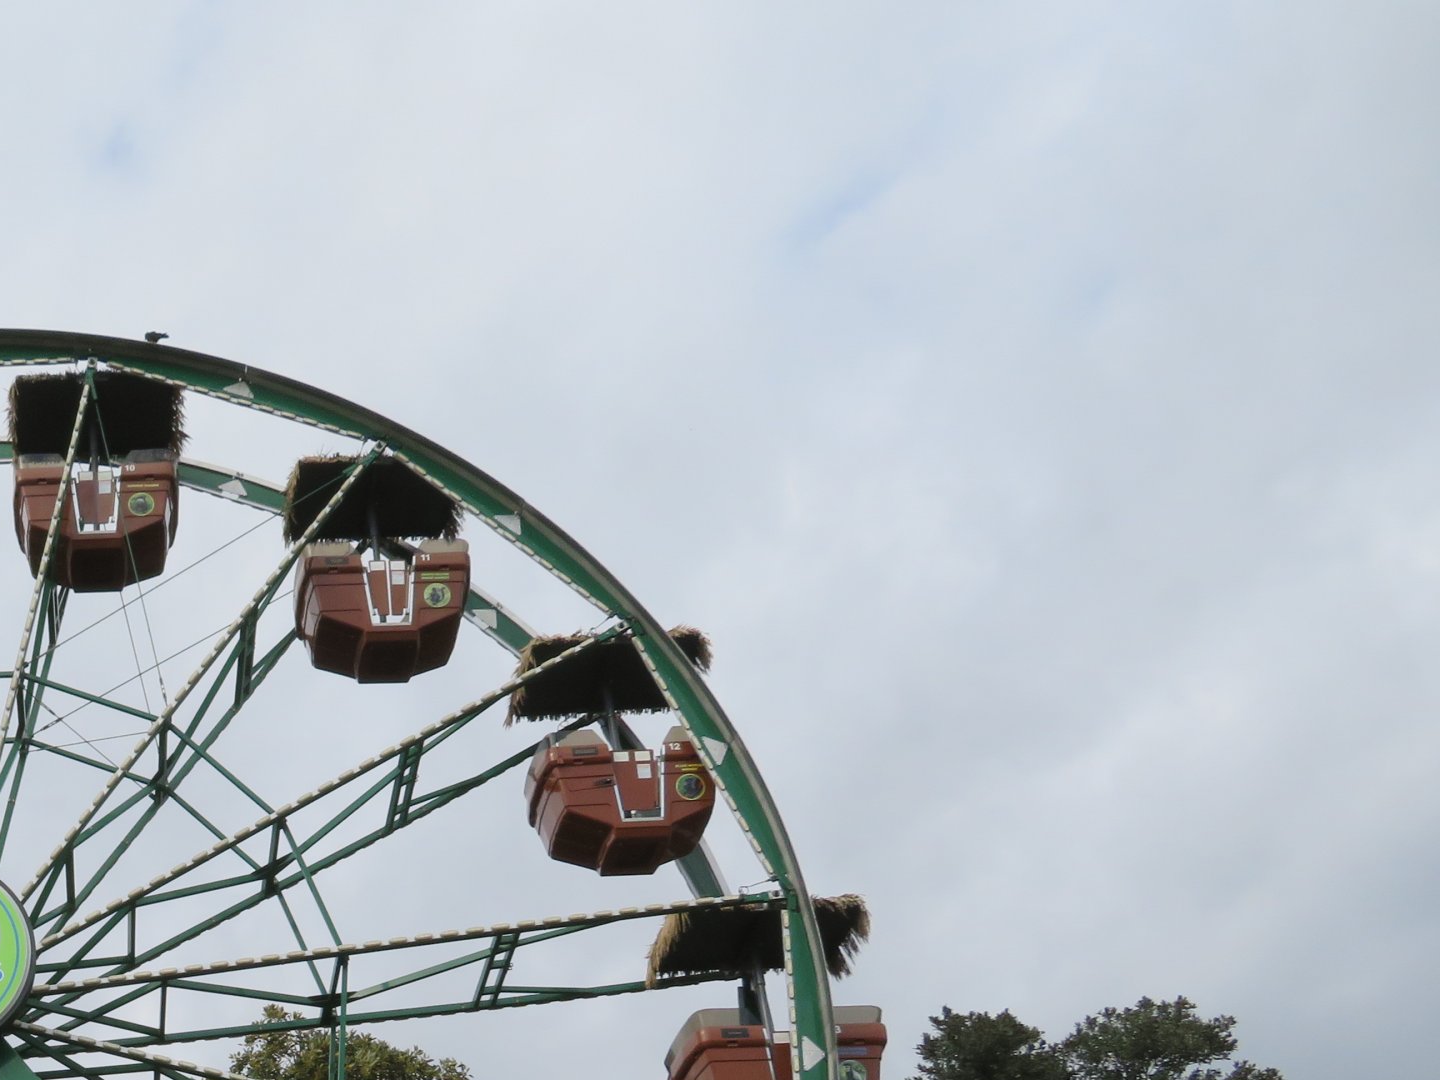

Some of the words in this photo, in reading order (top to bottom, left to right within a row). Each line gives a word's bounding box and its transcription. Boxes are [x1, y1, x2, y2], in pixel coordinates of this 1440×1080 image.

[125, 464, 136, 472] 10
[420, 553, 431, 561] 11
[668, 742, 681, 751] 12
